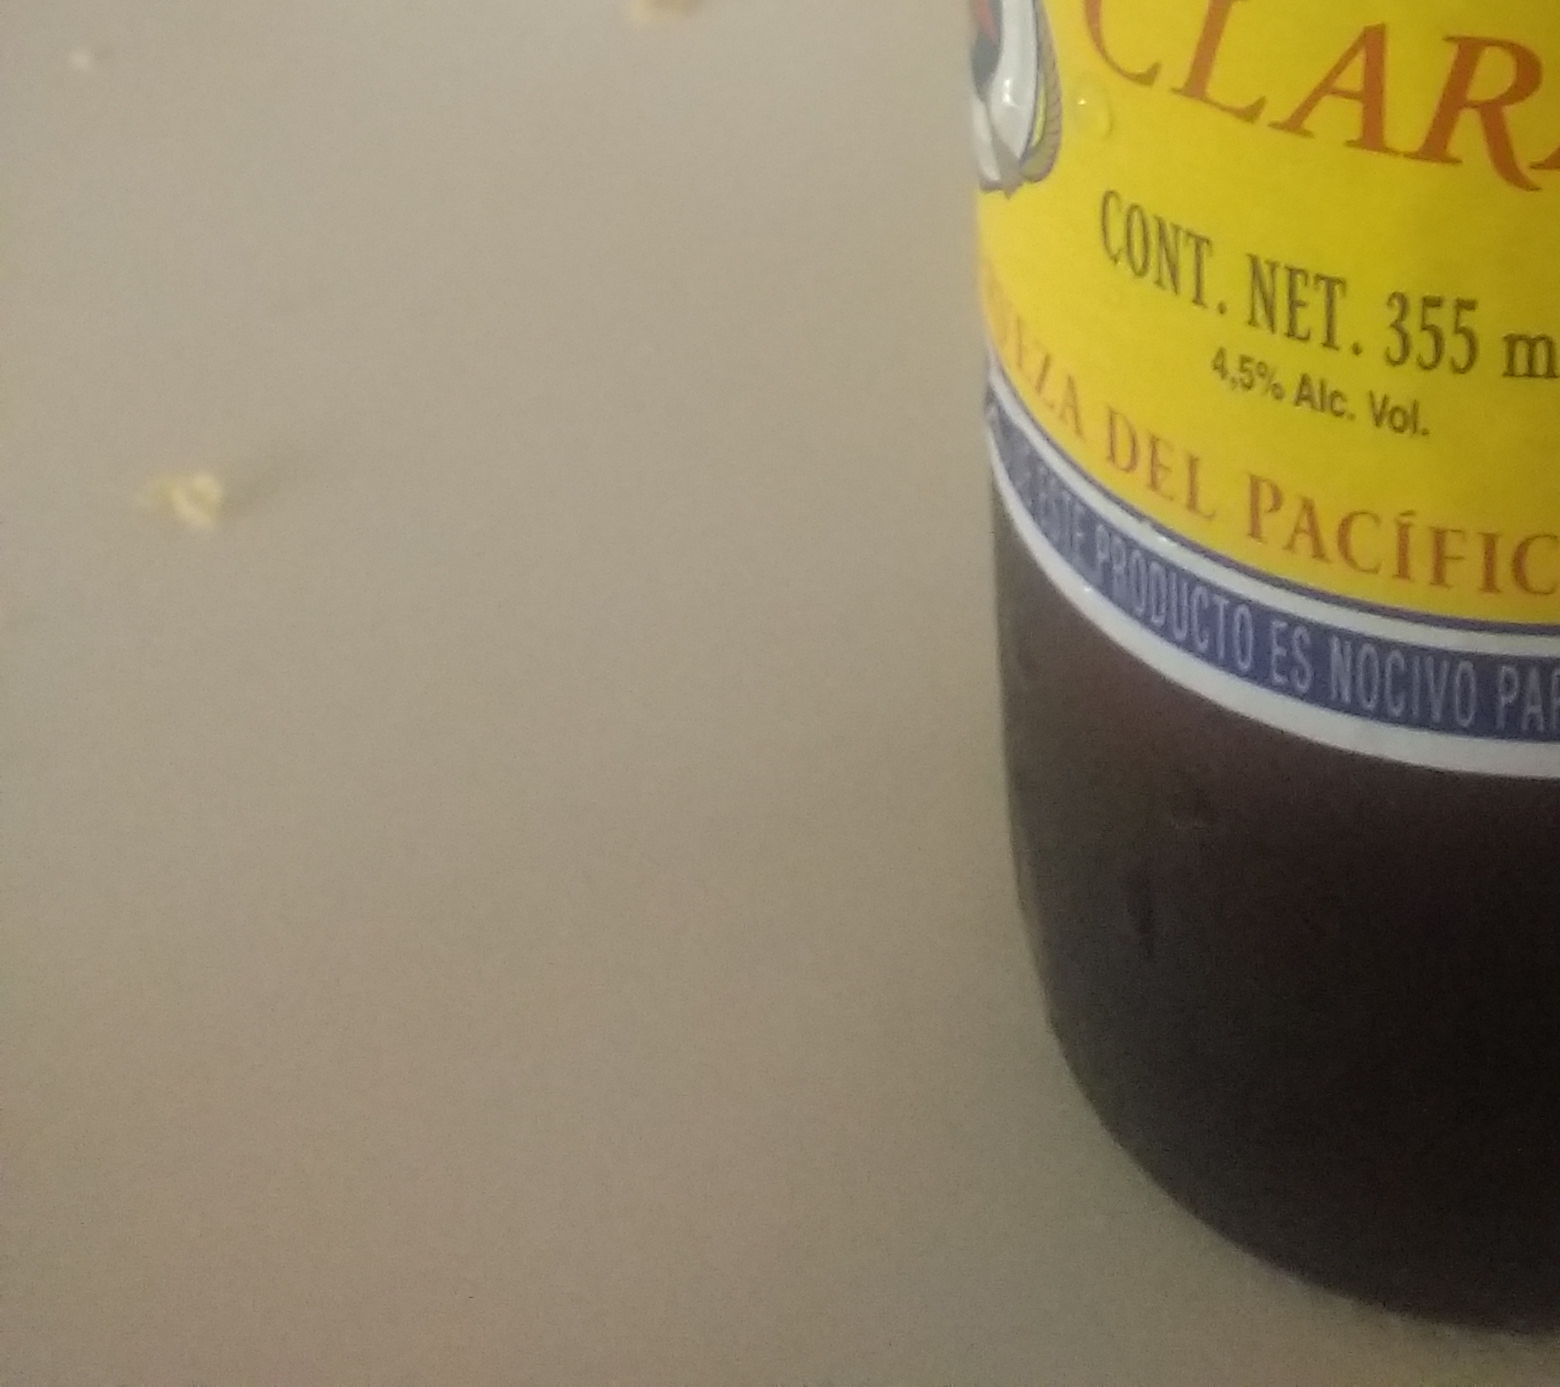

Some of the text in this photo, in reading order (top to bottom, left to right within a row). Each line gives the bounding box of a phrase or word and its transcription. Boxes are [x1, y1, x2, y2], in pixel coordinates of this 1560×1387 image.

[1101, 189, 1227, 315] CONT.
[1247, 253, 1364, 356] NET.
[1385, 291, 1480, 375] 355
[1105, 404, 1216, 521] DEL
[1212, 347, 1430, 436] 4,5% Alc. Vol.
[1096, 523, 1253, 674] PRODUCTO
[1270, 619, 1315, 694] ES
[1329, 636, 1477, 728] NOCIVO
